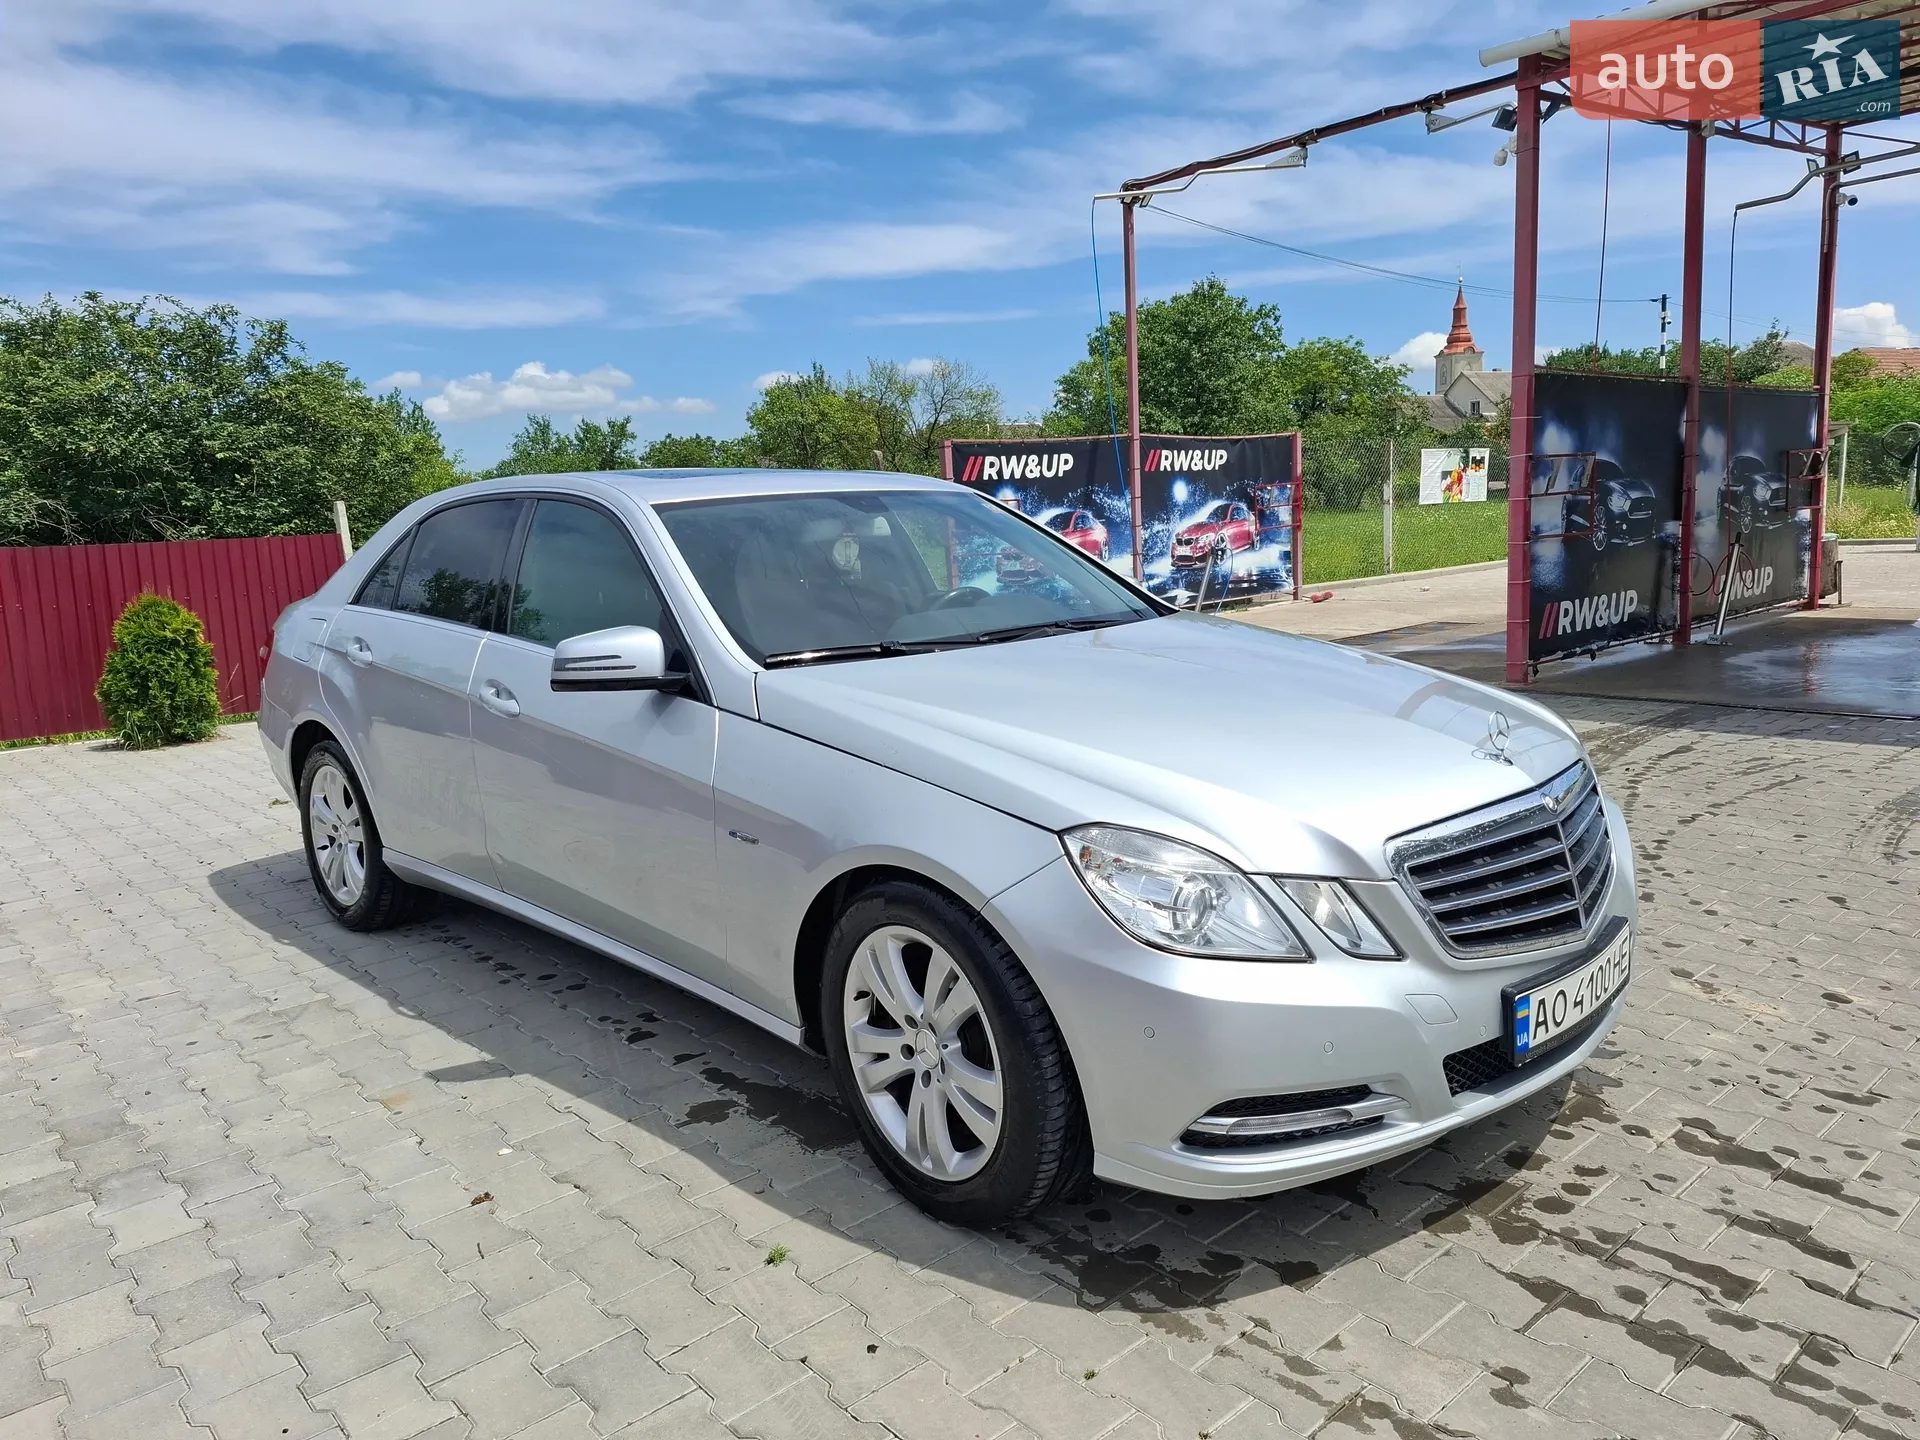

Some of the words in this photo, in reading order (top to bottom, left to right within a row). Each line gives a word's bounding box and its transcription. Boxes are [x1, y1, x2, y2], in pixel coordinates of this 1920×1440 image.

[1533, 989, 1567, 1040] AO
[1573, 956, 1611, 1015] 4100
[1517, 1033, 1529, 1046] UA
